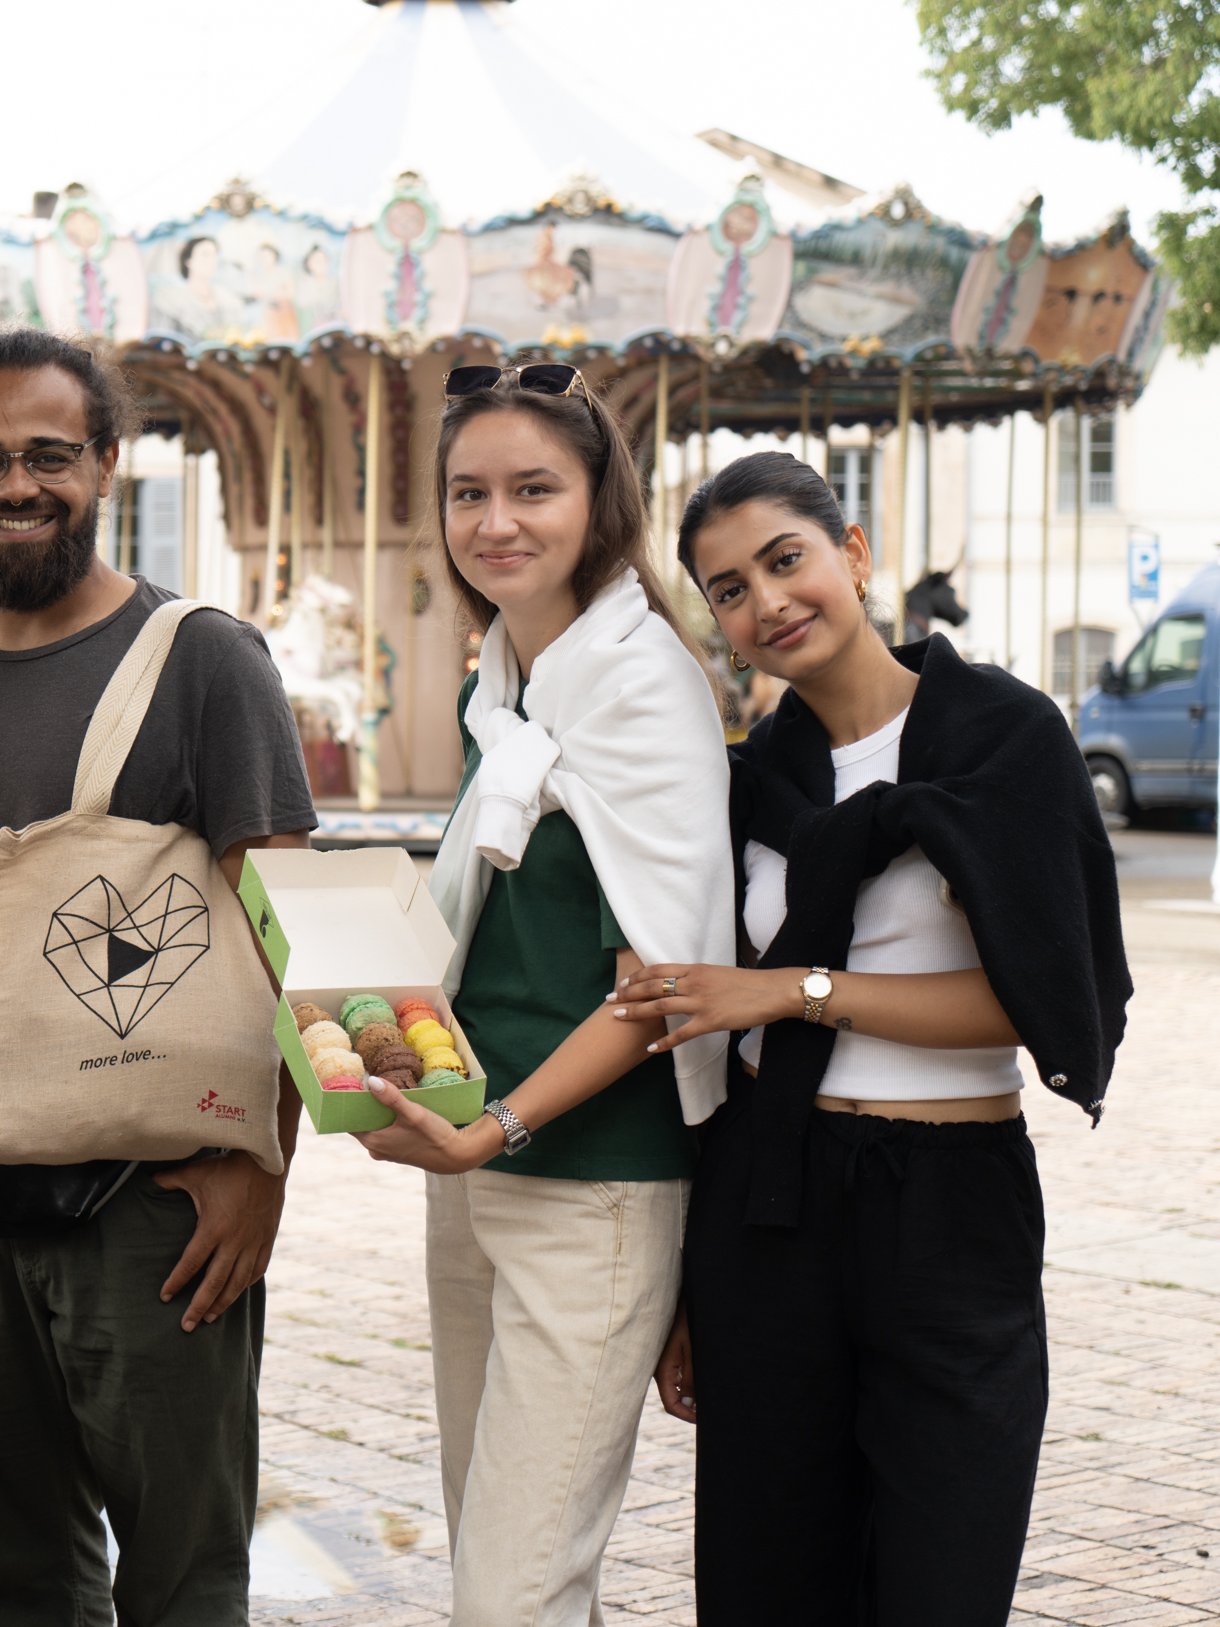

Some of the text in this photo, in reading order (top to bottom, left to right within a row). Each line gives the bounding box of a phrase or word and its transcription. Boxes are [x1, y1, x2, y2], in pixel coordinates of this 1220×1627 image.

[79, 1049, 167, 1071] more love...
[215, 1104, 247, 1118] START
[215, 1113, 236, 1121] ALUMNI
